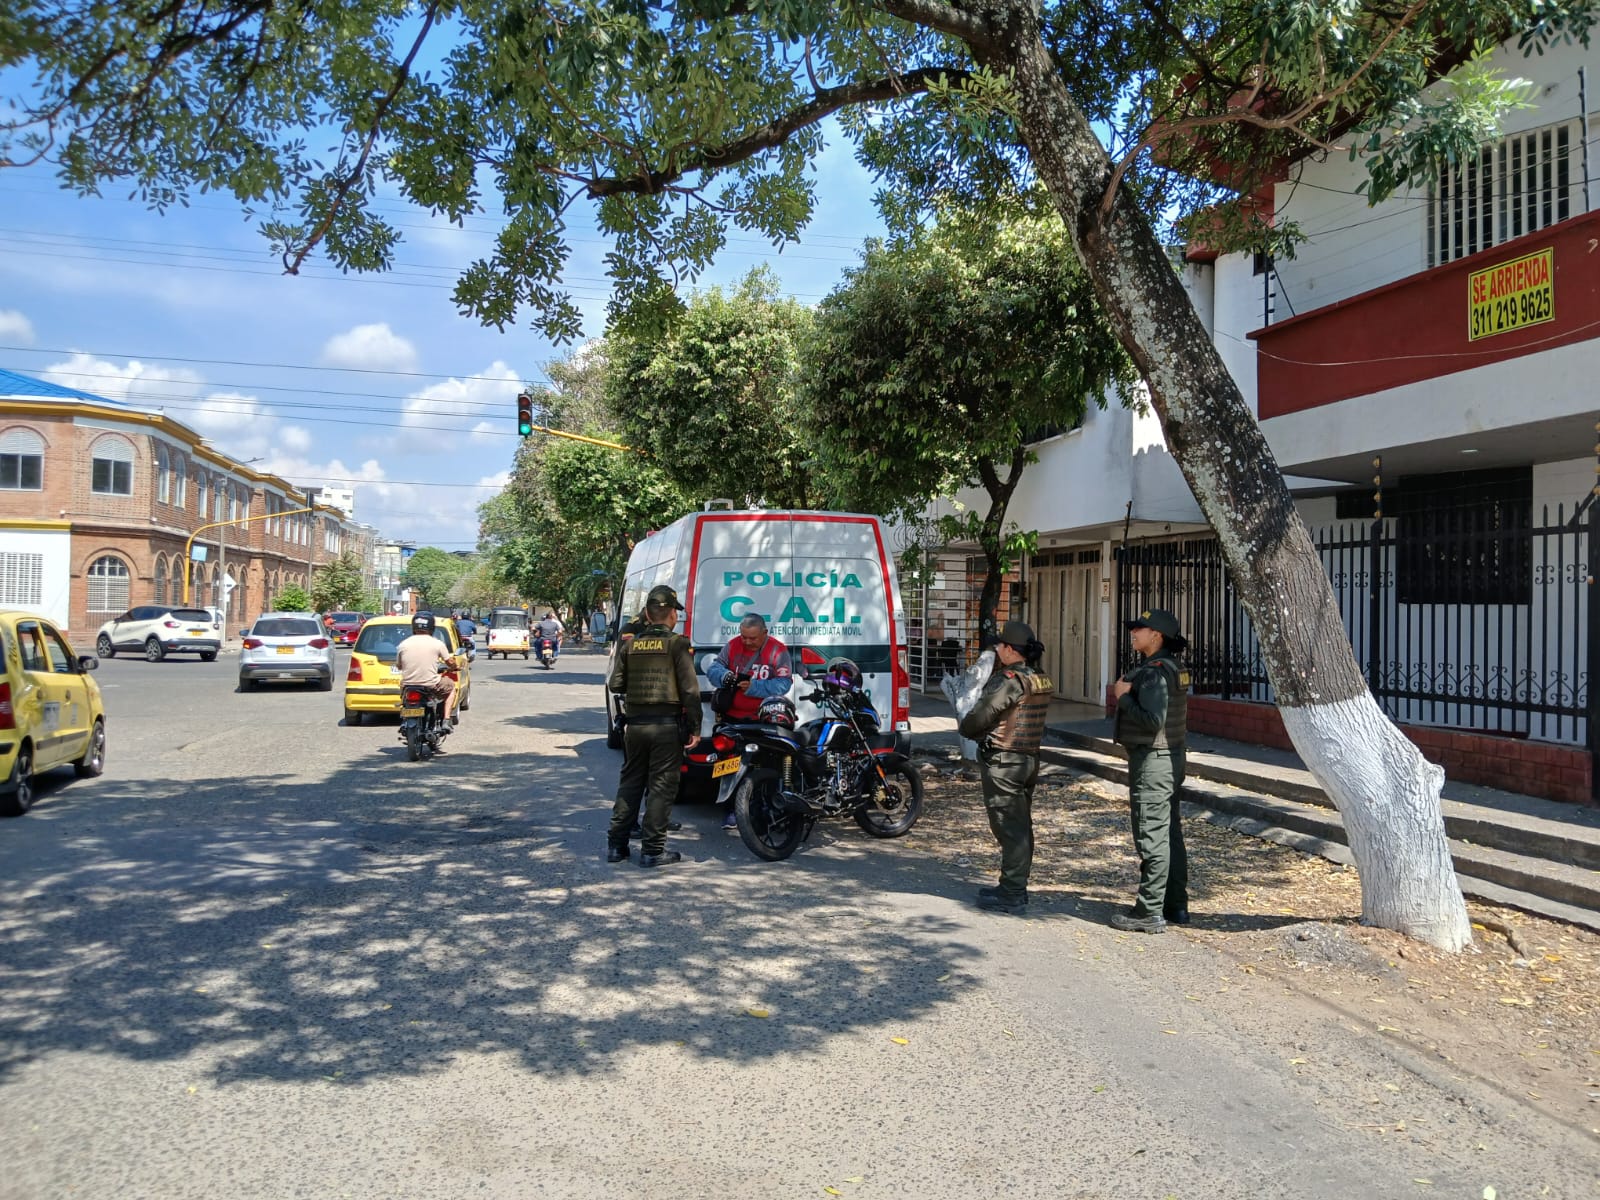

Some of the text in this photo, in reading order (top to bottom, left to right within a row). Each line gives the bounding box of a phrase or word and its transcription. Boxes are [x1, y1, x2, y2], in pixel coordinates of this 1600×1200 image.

[1473, 255, 1549, 304] SE ARRIENDA
[1473, 287, 1550, 335] 311 219 9625
[723, 569, 862, 588] POLICÍA
[805, 626, 840, 636] INMEDIATA
[632, 640, 663, 650] POLICIA
